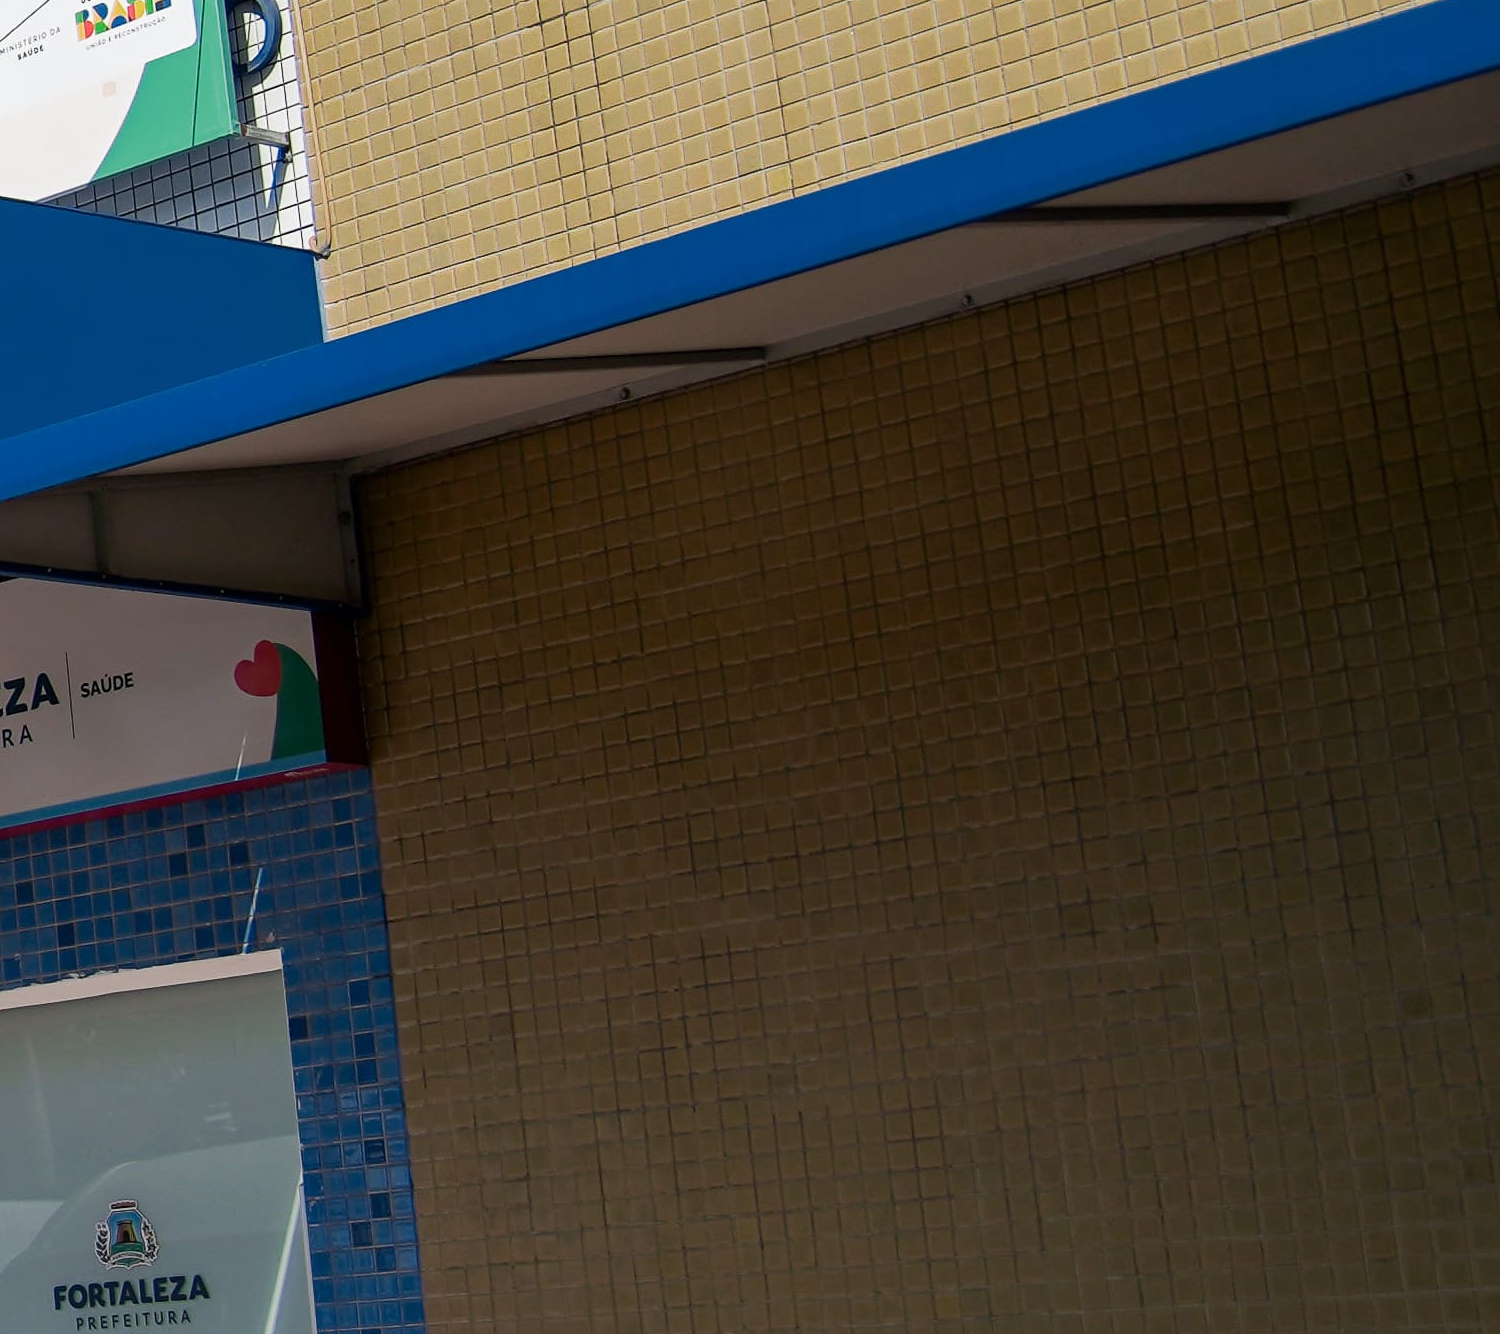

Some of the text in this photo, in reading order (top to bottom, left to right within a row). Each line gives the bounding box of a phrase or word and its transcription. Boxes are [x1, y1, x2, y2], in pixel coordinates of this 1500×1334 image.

[80, 671, 135, 699] SAÚDE
[53, 1275, 211, 1310] FORTALEZA
[76, 1310, 191, 1331] PREFEITURA
